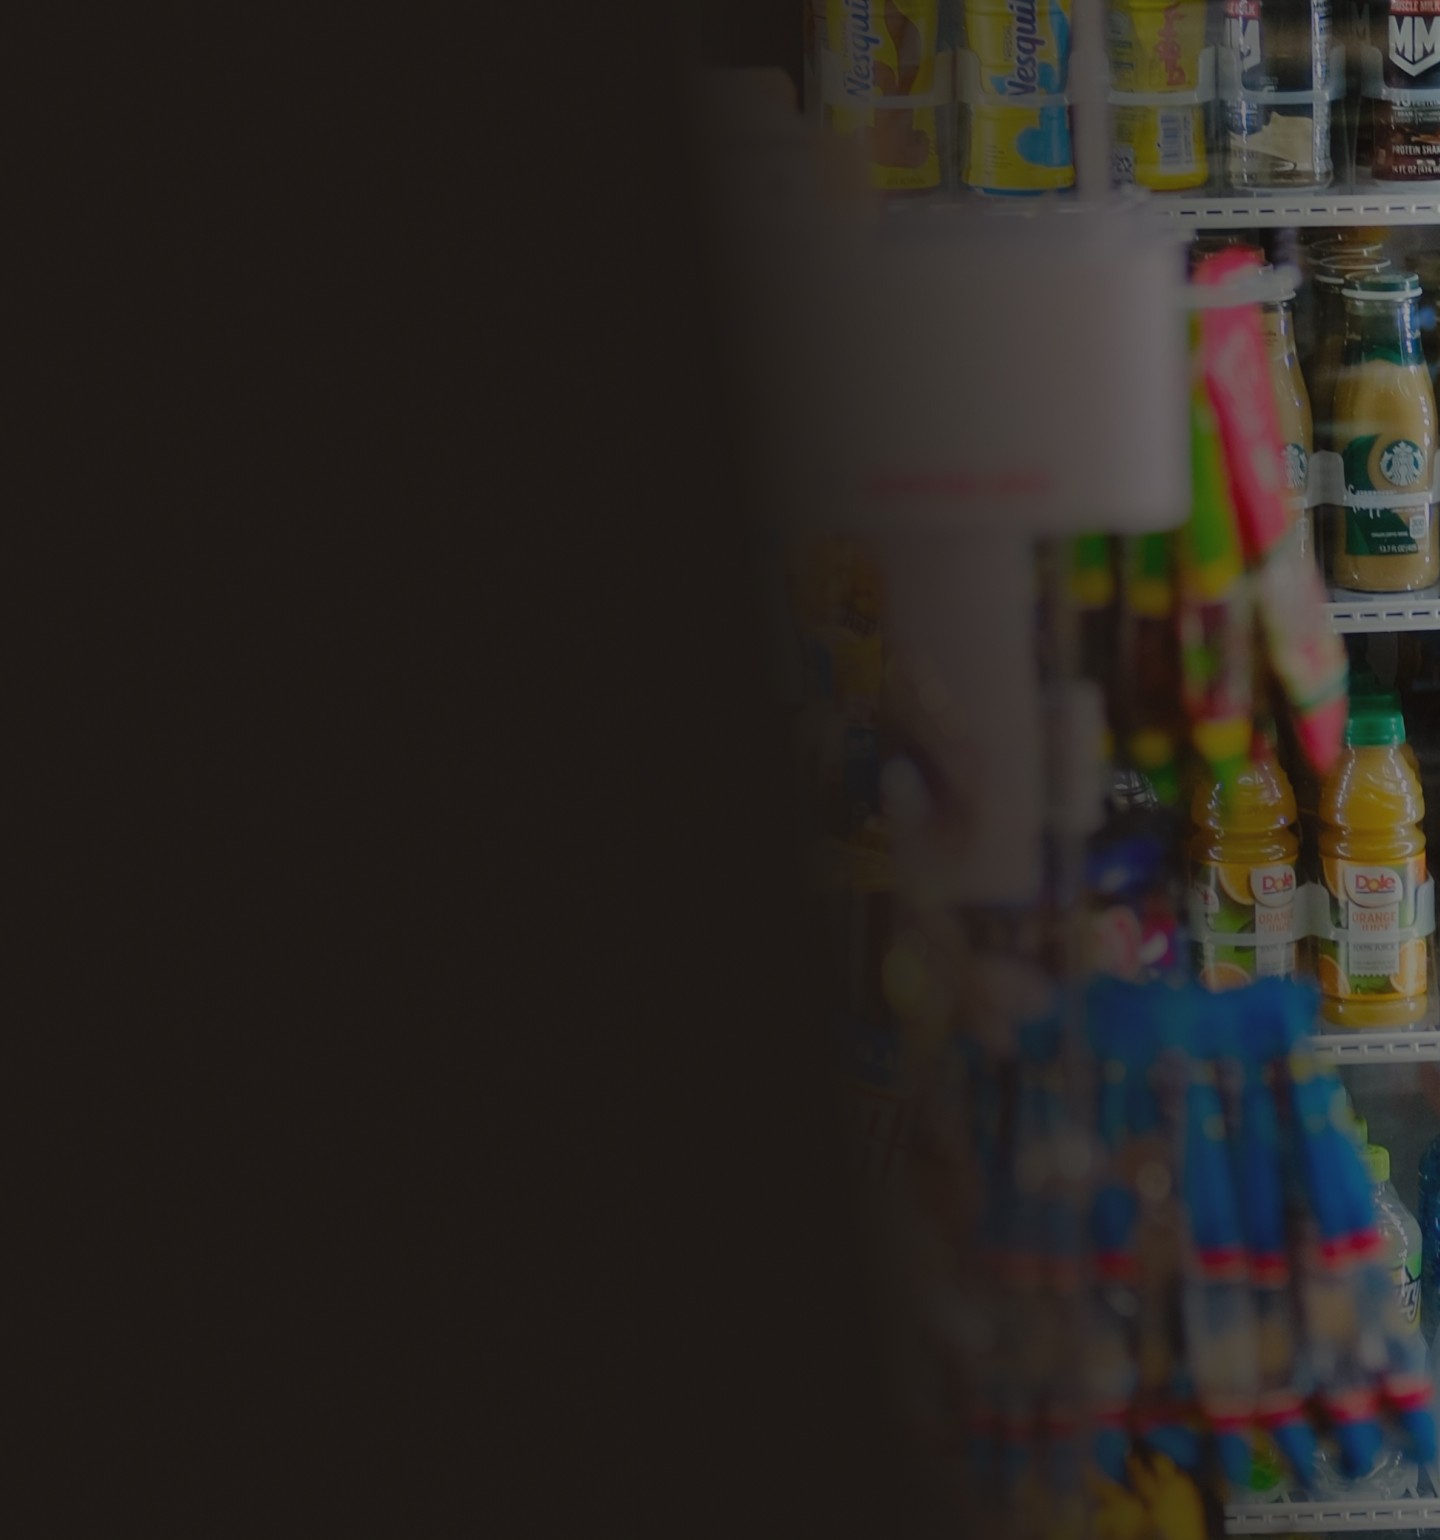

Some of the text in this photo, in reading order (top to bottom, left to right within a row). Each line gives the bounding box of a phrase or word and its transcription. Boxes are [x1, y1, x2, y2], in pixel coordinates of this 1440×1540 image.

[1392, 144, 1421, 155] PROTEIN
[1262, 871, 1293, 891] Dole
[1355, 874, 1396, 893] Dole
[1352, 911, 1396, 923] ORANGE
